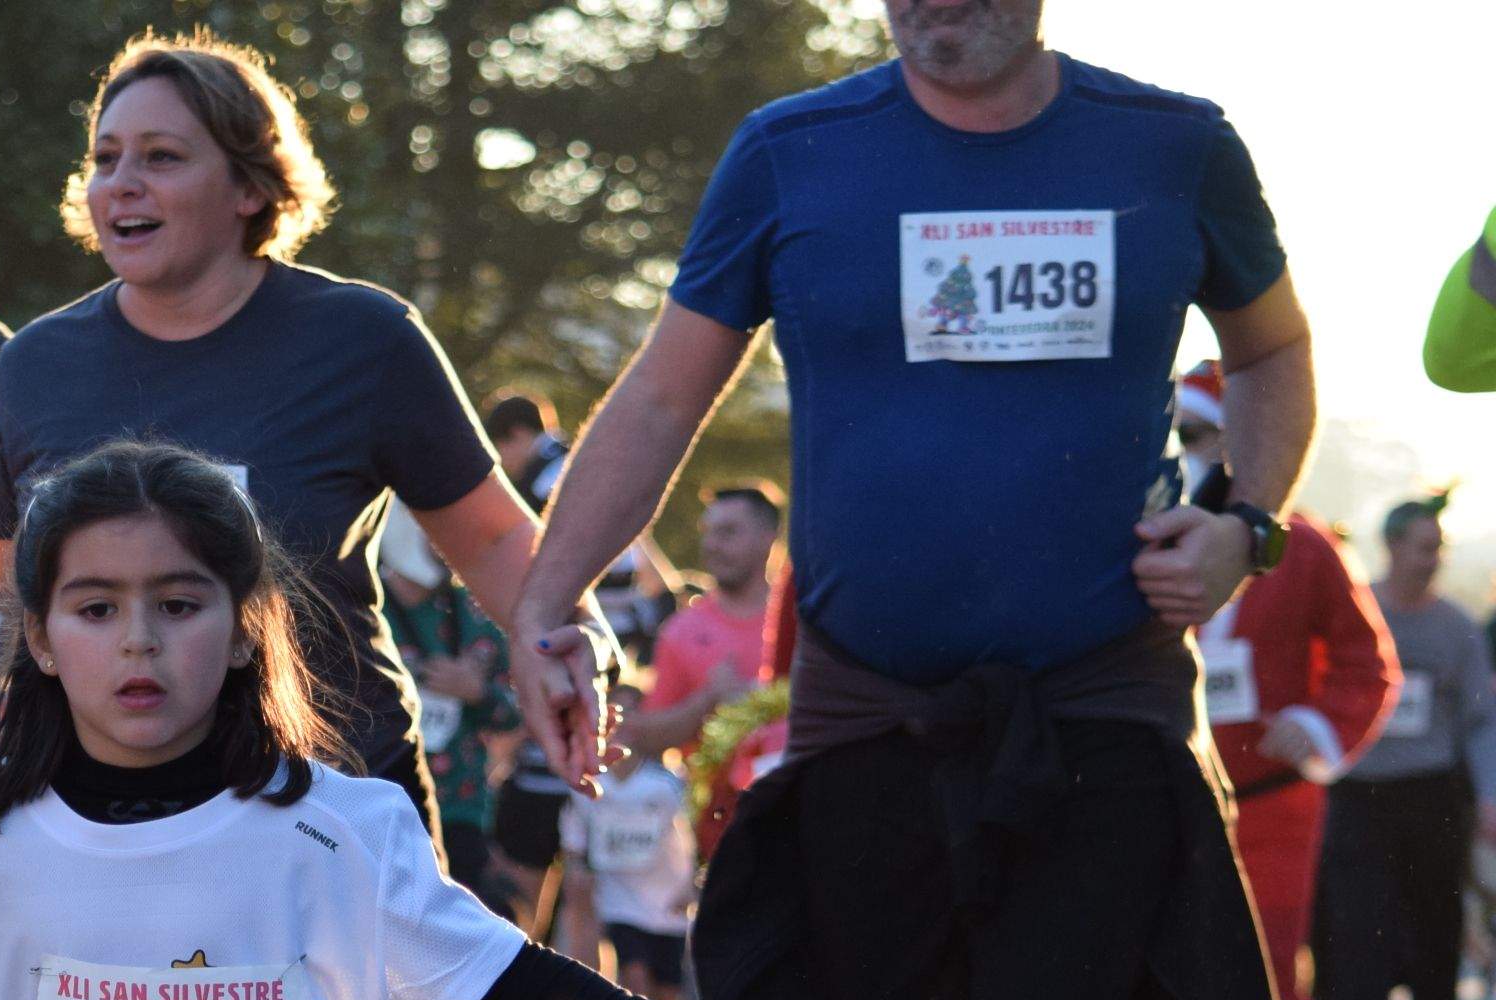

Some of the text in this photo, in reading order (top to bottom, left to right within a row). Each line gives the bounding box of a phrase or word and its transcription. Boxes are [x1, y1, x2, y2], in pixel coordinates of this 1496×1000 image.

[956, 221, 994, 239] SAN
[1001, 220, 1096, 237] SILVESTRE
[985, 260, 1097, 314] 1438
[295, 820, 339, 854] RUNNEK
[57, 973, 90, 1000] XLI
